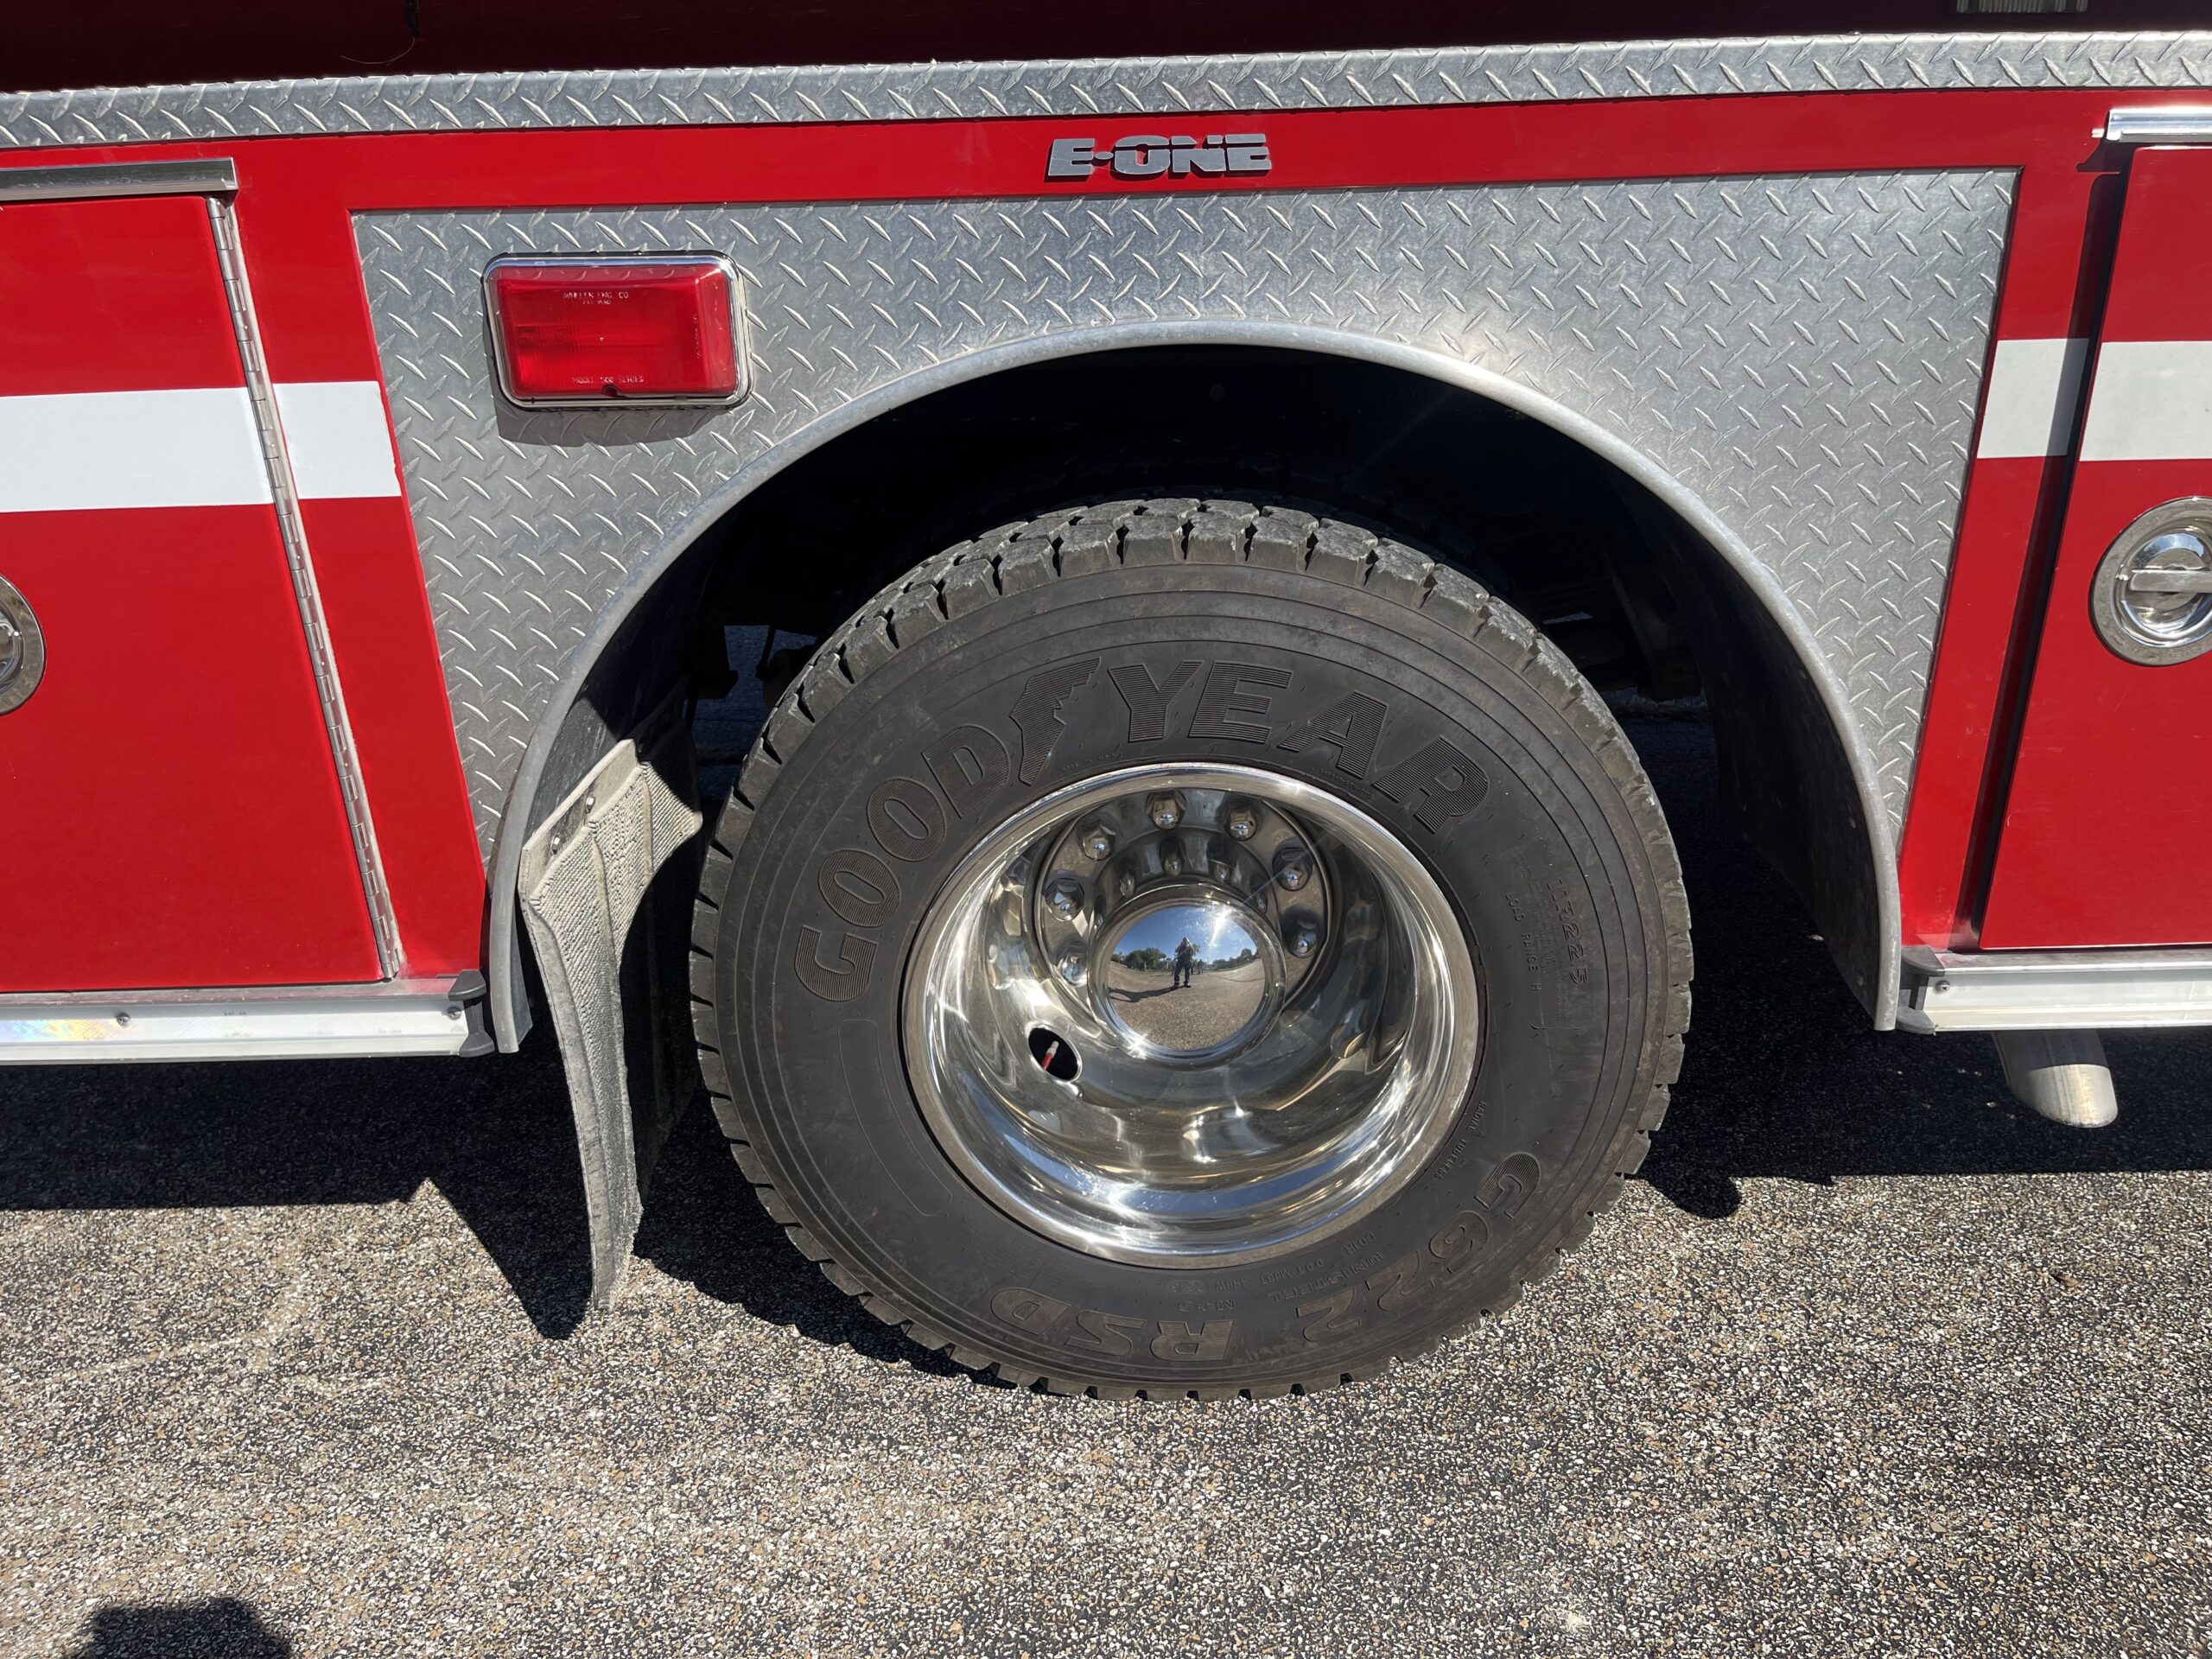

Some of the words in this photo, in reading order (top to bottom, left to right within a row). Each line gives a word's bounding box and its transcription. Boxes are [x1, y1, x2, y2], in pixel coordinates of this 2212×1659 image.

[1505, 893, 1526, 922] LOAD
[1521, 932, 1539, 972] RANGE
[1295, 1151, 1542, 1343] G622
[989, 1287, 1235, 1363] RSD
